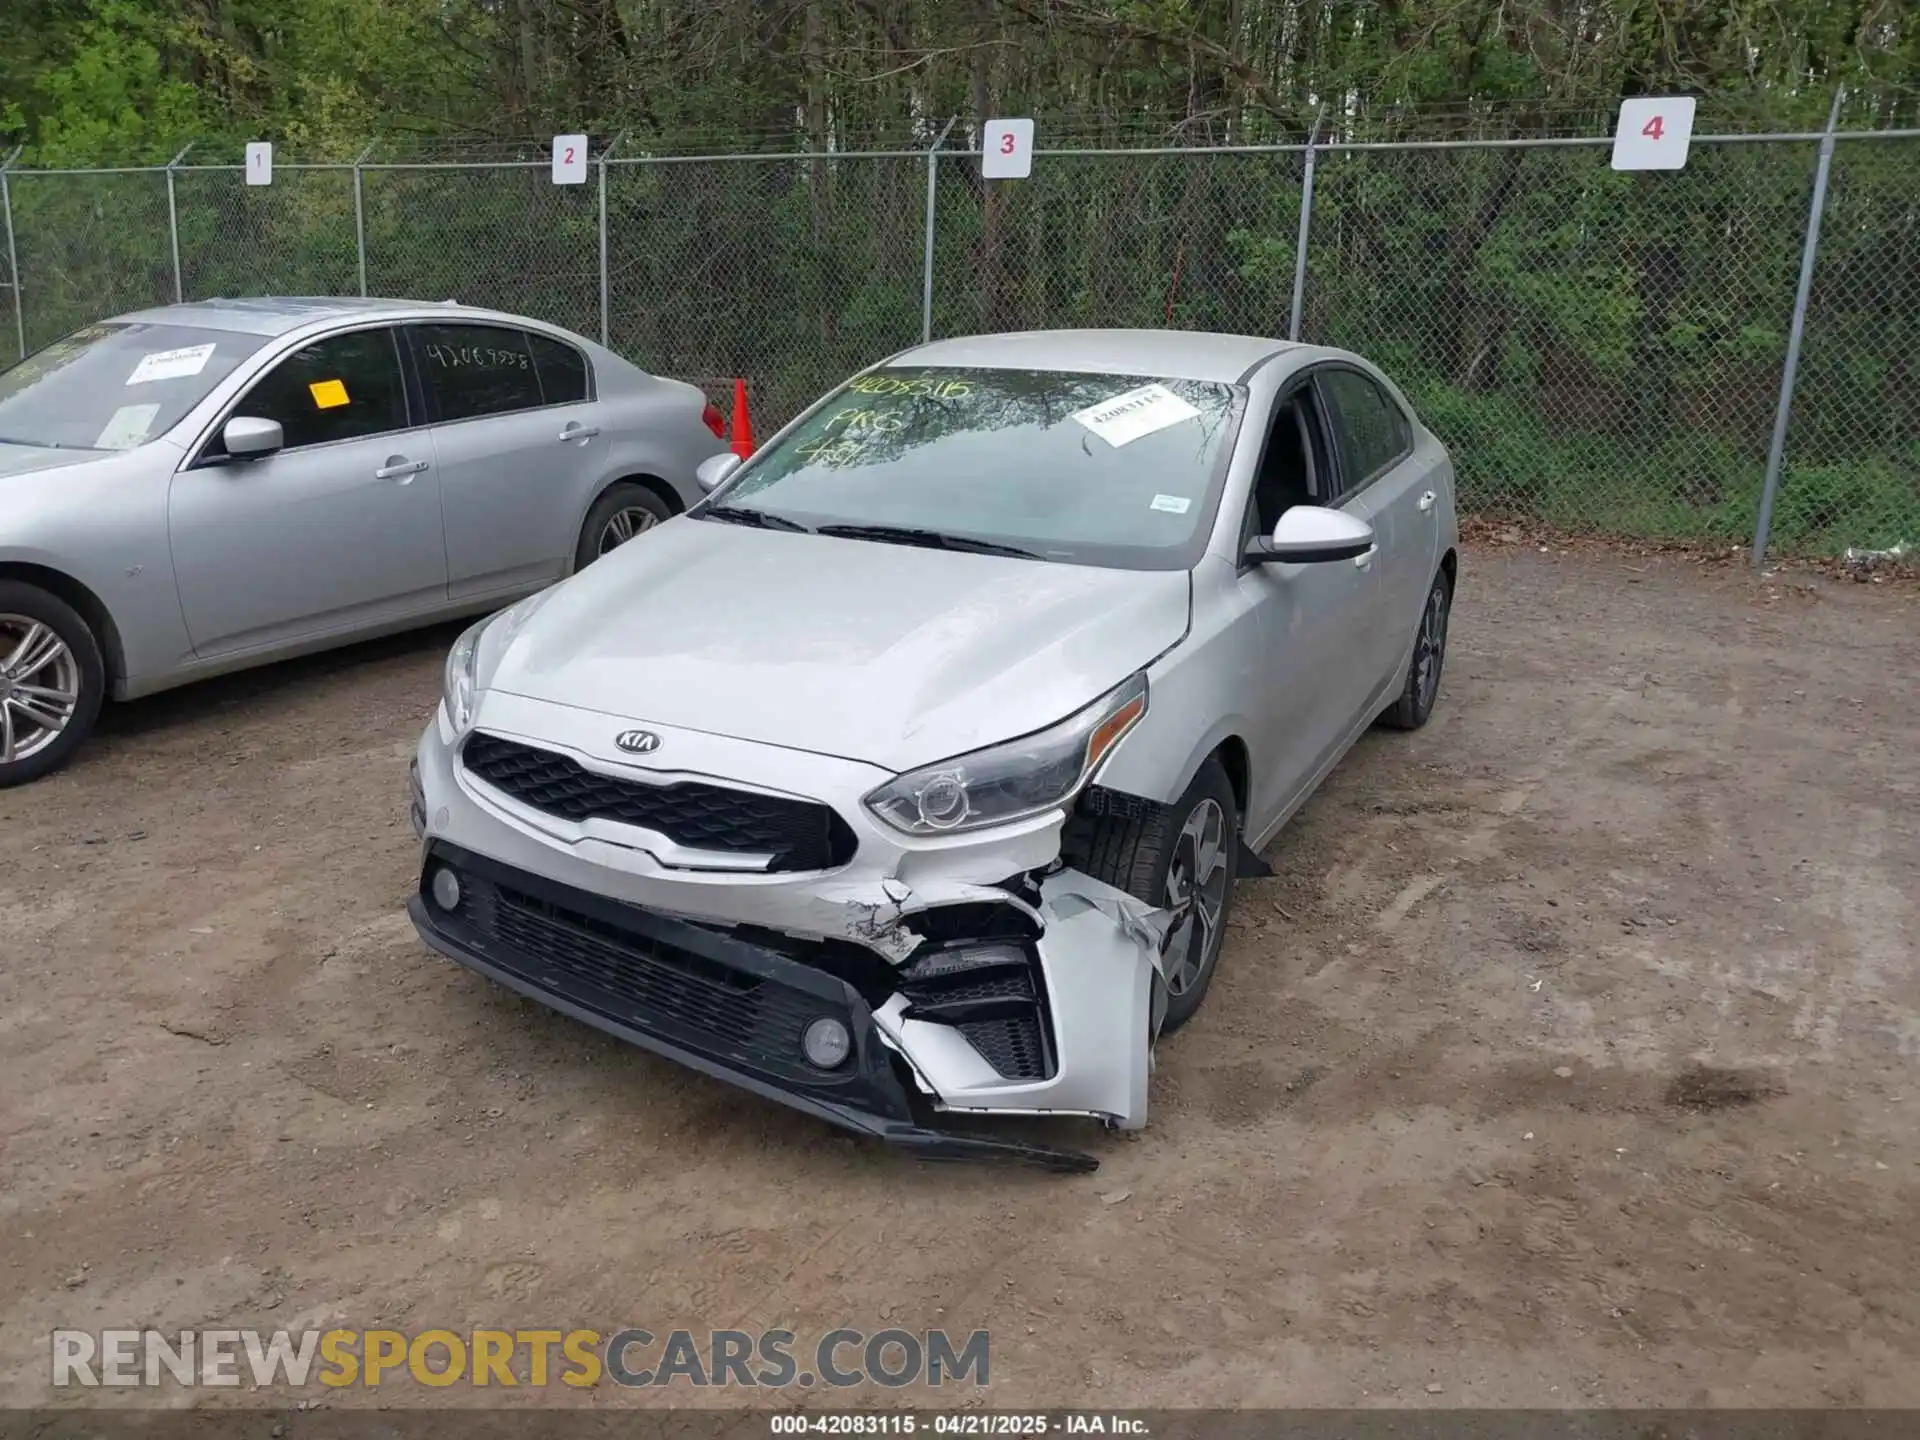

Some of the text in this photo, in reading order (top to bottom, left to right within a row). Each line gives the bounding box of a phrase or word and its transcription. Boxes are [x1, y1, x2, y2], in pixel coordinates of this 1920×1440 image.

[1641, 115, 1666, 141] 4
[999, 134, 1016, 155] 3
[255, 152, 261, 168] 1
[563, 147, 575, 165] 2
[619, 732, 654, 750] KIA
